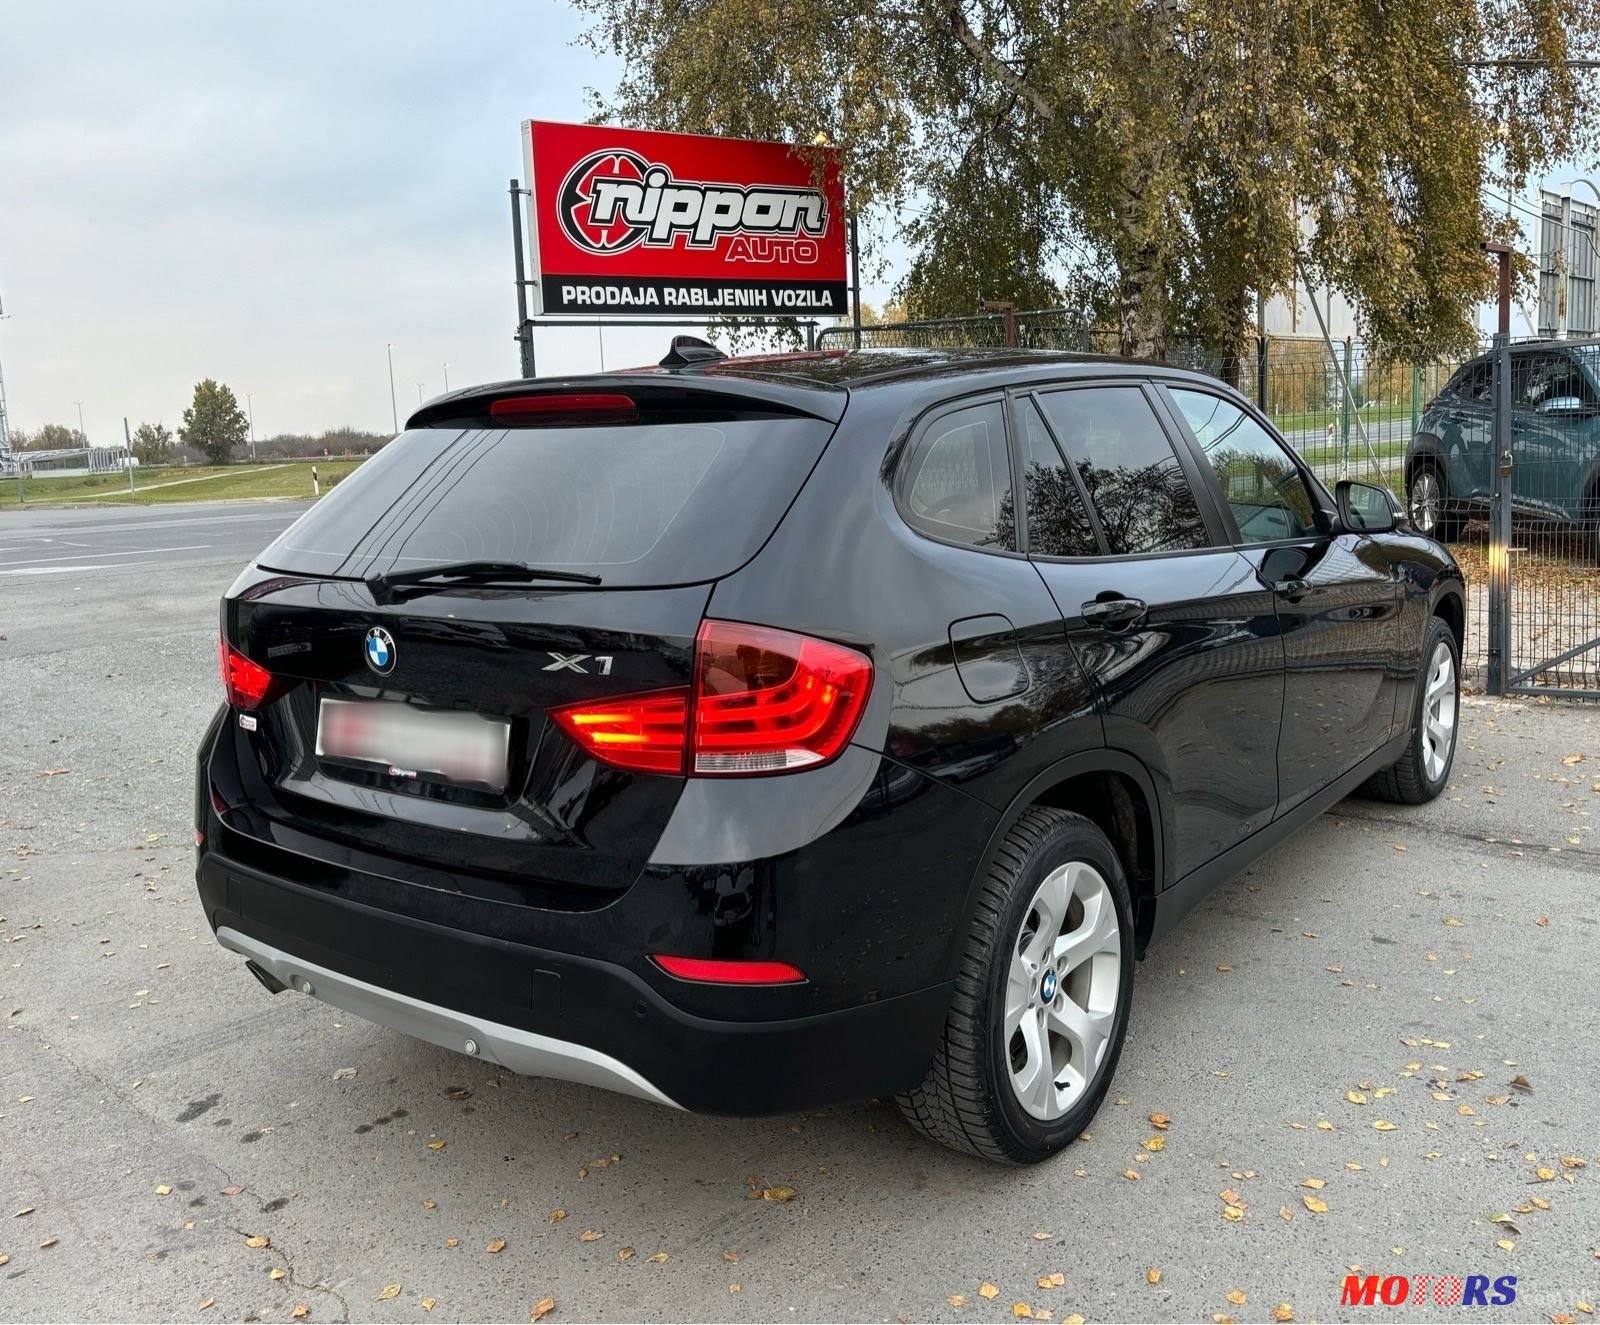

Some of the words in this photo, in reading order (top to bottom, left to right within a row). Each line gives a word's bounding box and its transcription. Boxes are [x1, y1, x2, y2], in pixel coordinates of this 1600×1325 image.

[592, 168, 825, 244] nippon
[725, 236, 819, 264] AUTO
[561, 285, 660, 306] PRODAJA
[663, 287, 768, 308] RABLJENIH
[772, 289, 834, 307] VOZILA
[541, 652, 615, 676] X1
